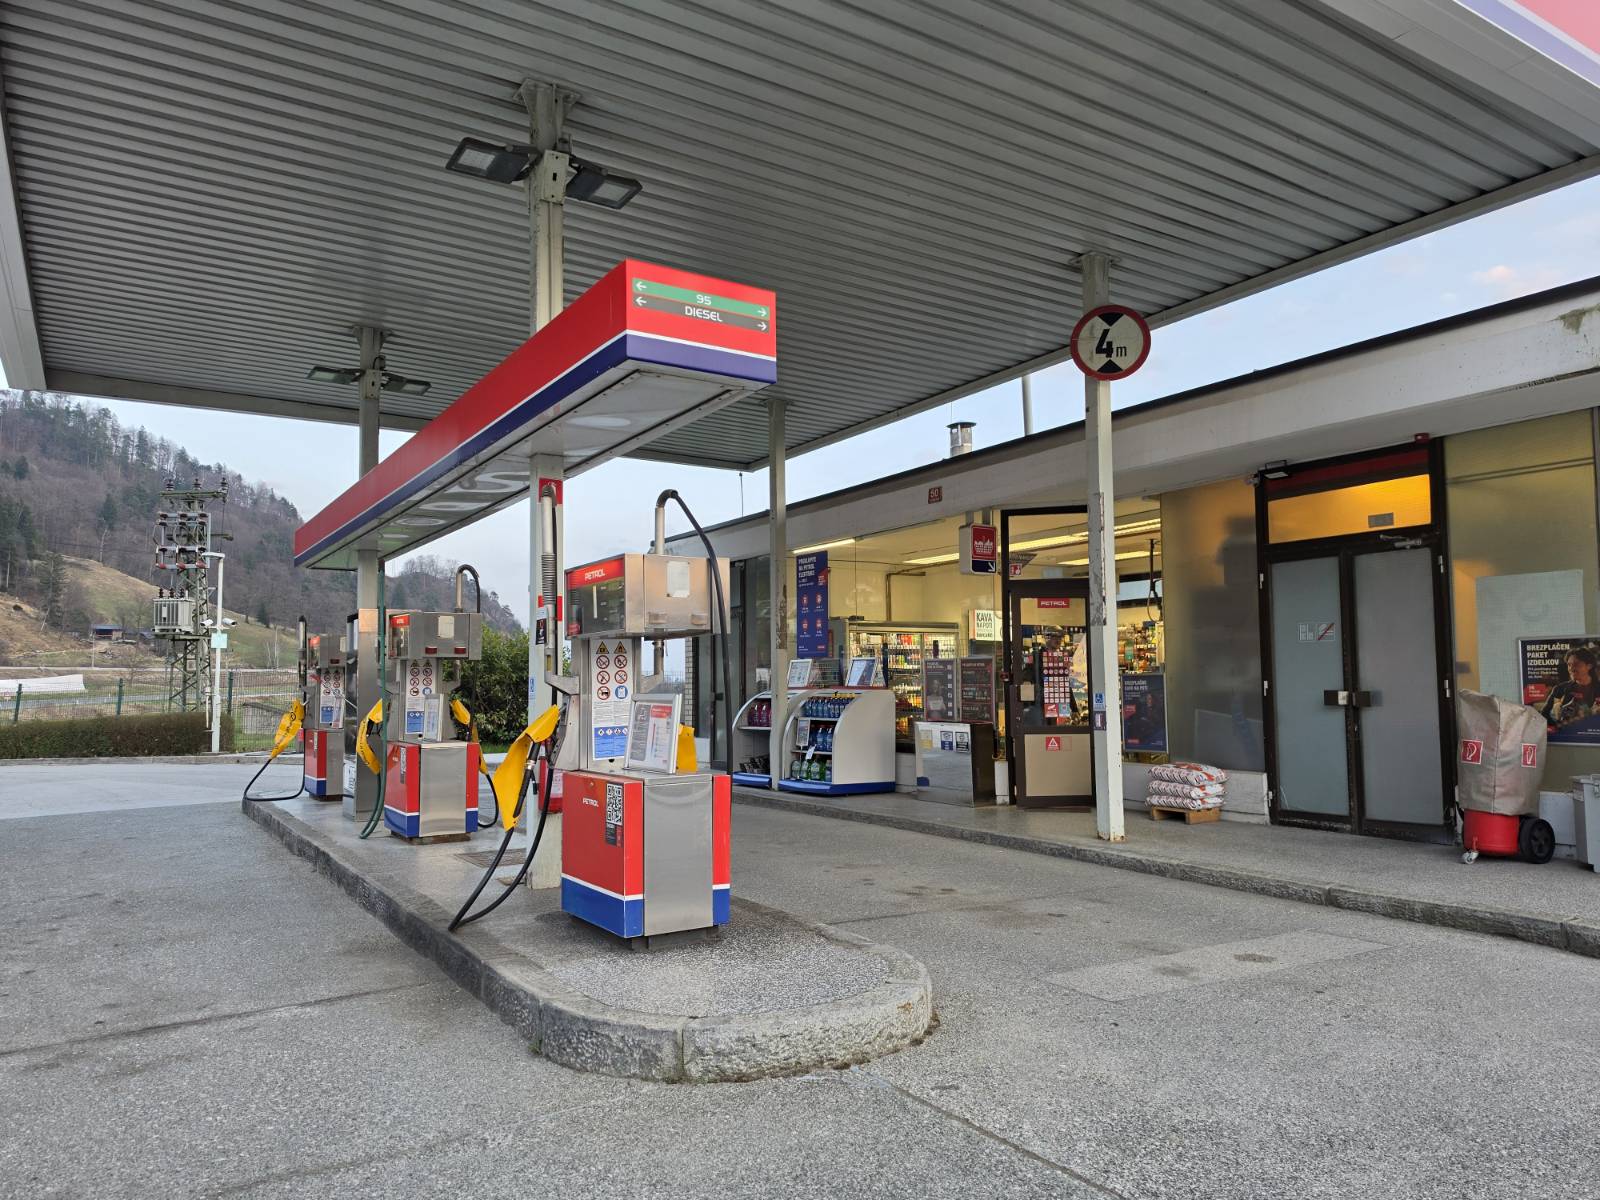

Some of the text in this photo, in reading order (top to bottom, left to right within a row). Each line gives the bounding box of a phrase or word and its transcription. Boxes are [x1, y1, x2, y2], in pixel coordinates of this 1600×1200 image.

[696, 294, 712, 306] 95
[684, 306, 722, 322] DIESEL
[930, 488, 938, 498] 50
[584, 568, 606, 581] PETROL
[976, 612, 992, 622] KAVA
[1526, 643, 1570, 651] BREZPLAČEN
[582, 798, 599, 807] PETROL
